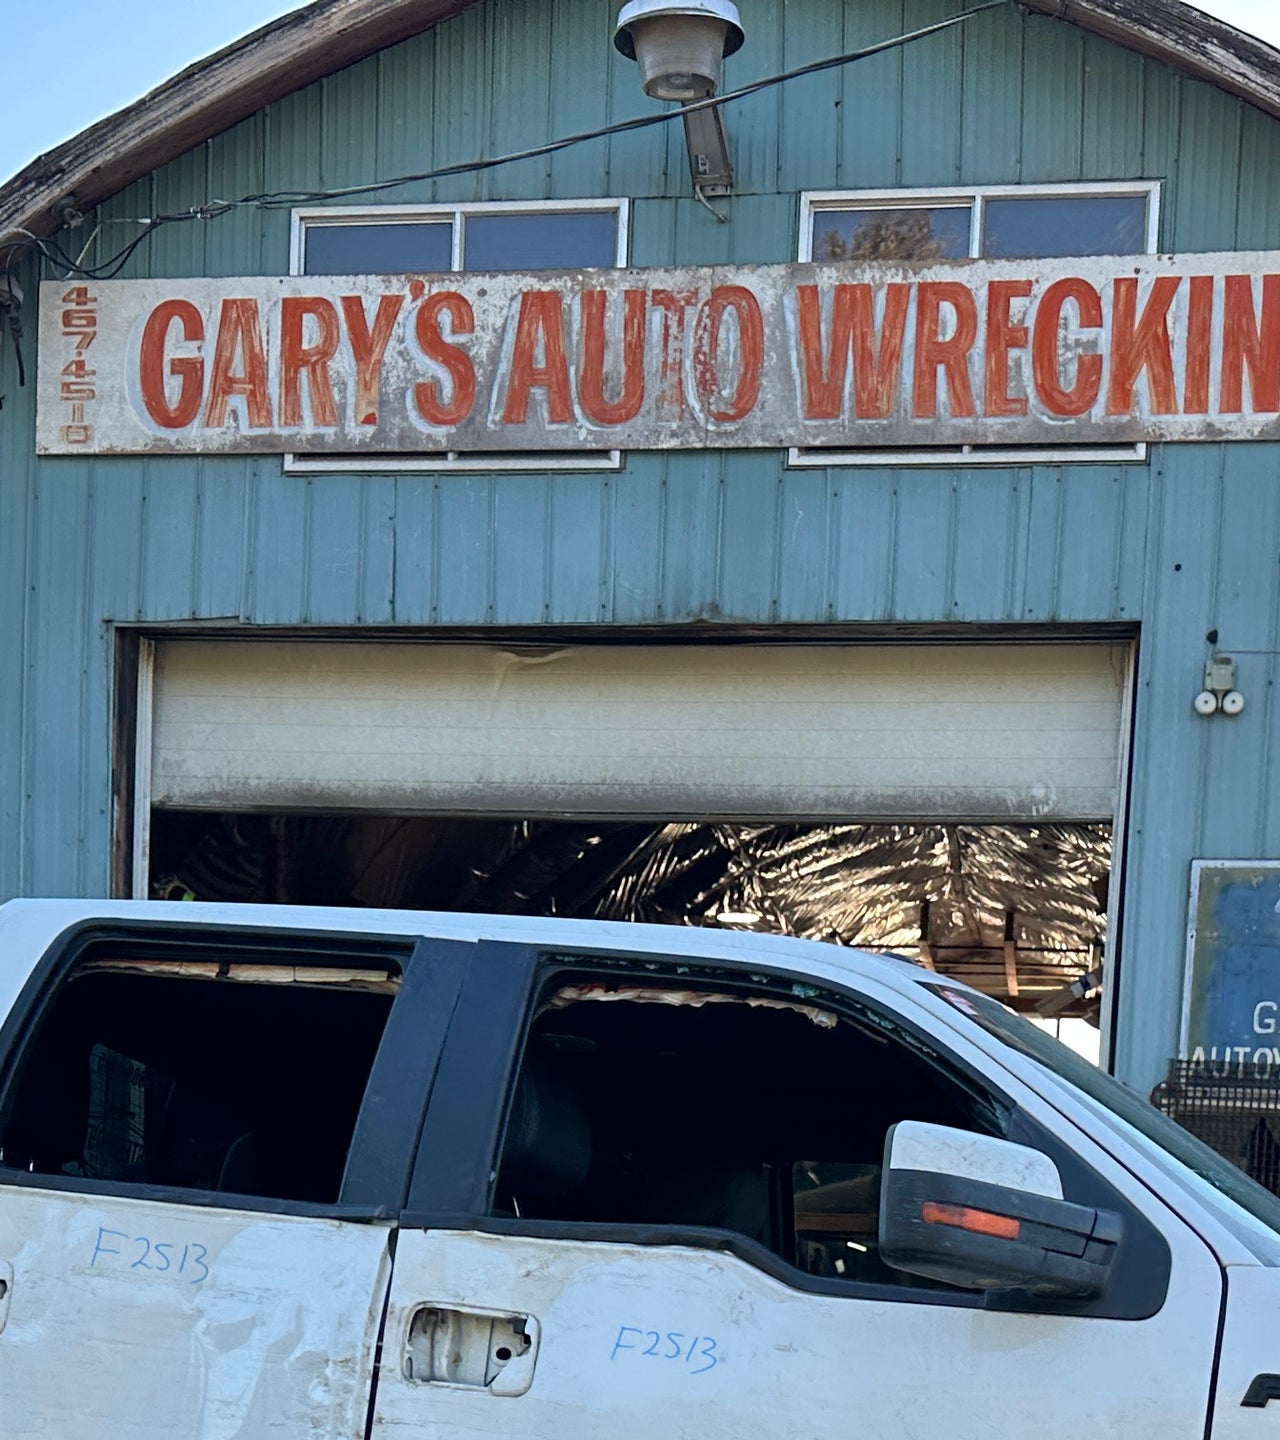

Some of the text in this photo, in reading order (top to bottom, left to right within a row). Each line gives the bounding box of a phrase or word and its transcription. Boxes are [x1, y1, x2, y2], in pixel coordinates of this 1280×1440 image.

[139, 279, 475, 428] GARY'S
[503, 284, 765, 425] AUTO
[90, 1226, 210, 1284] F2513
[610, 1326, 719, 1375] F2513
